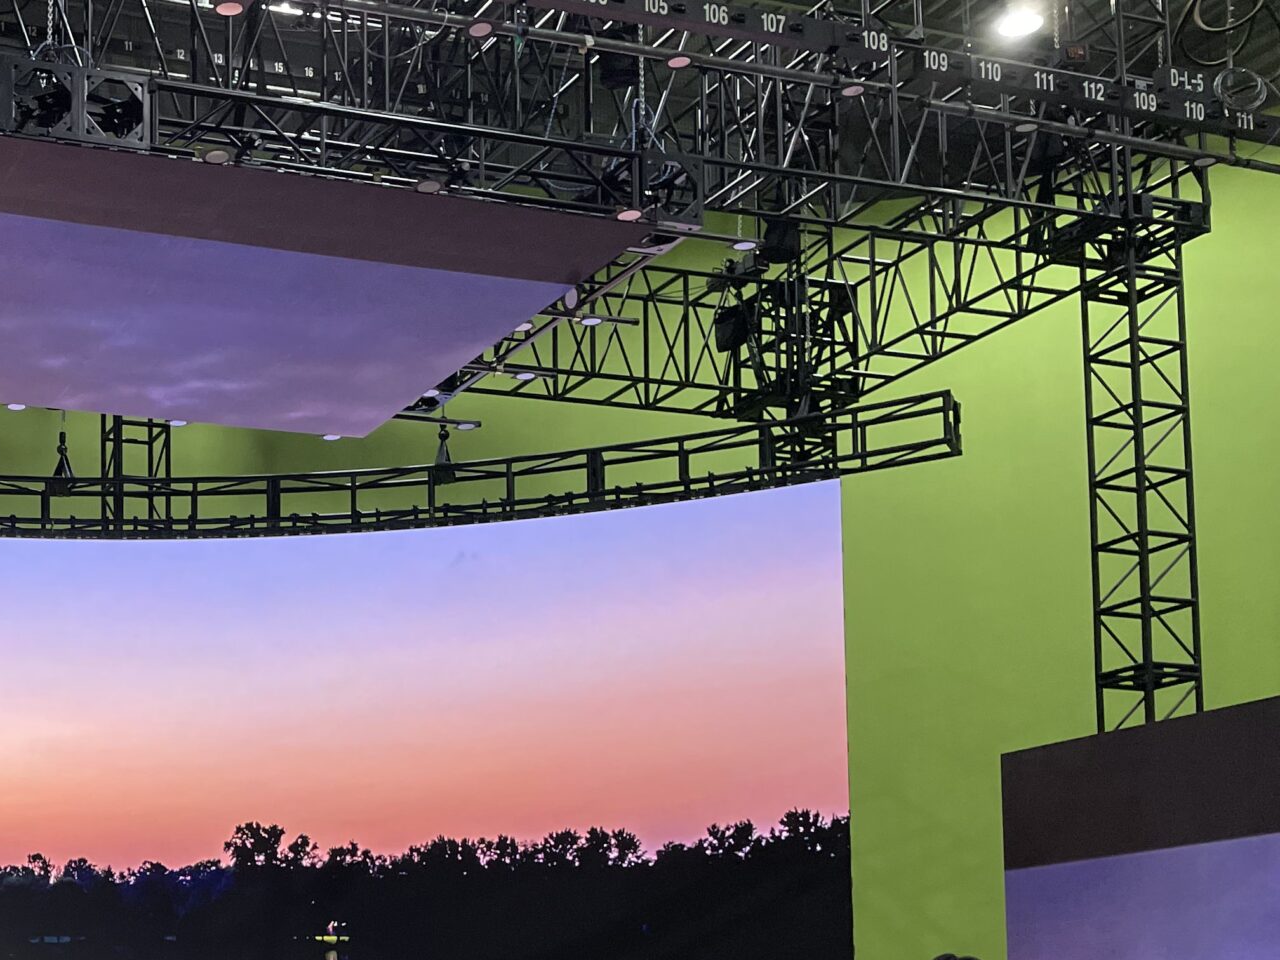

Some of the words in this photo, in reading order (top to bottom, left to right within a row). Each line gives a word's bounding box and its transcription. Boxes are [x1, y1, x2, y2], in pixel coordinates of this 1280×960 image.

[644, 0, 668, 15] 105
[703, 4, 728, 25] 106
[761, 13, 786, 34] 107
[862, 30, 888, 51] 108
[124, 41, 133, 52] 11
[176, 49, 185, 60] 12
[213, 53, 223, 64] 13
[274, 62, 284, 73] 15
[304, 66, 314, 78] 16
[923, 50, 948, 72] 109
[979, 60, 1001, 82] 110
[1034, 70, 1054, 92] 111
[1082, 80, 1105, 101] 112
[1170, 68, 1204, 92] D-L-5
[1133, 91, 1157, 112] 109
[1184, 101, 1205, 121] 110
[1236, 111, 1254, 130] 111
